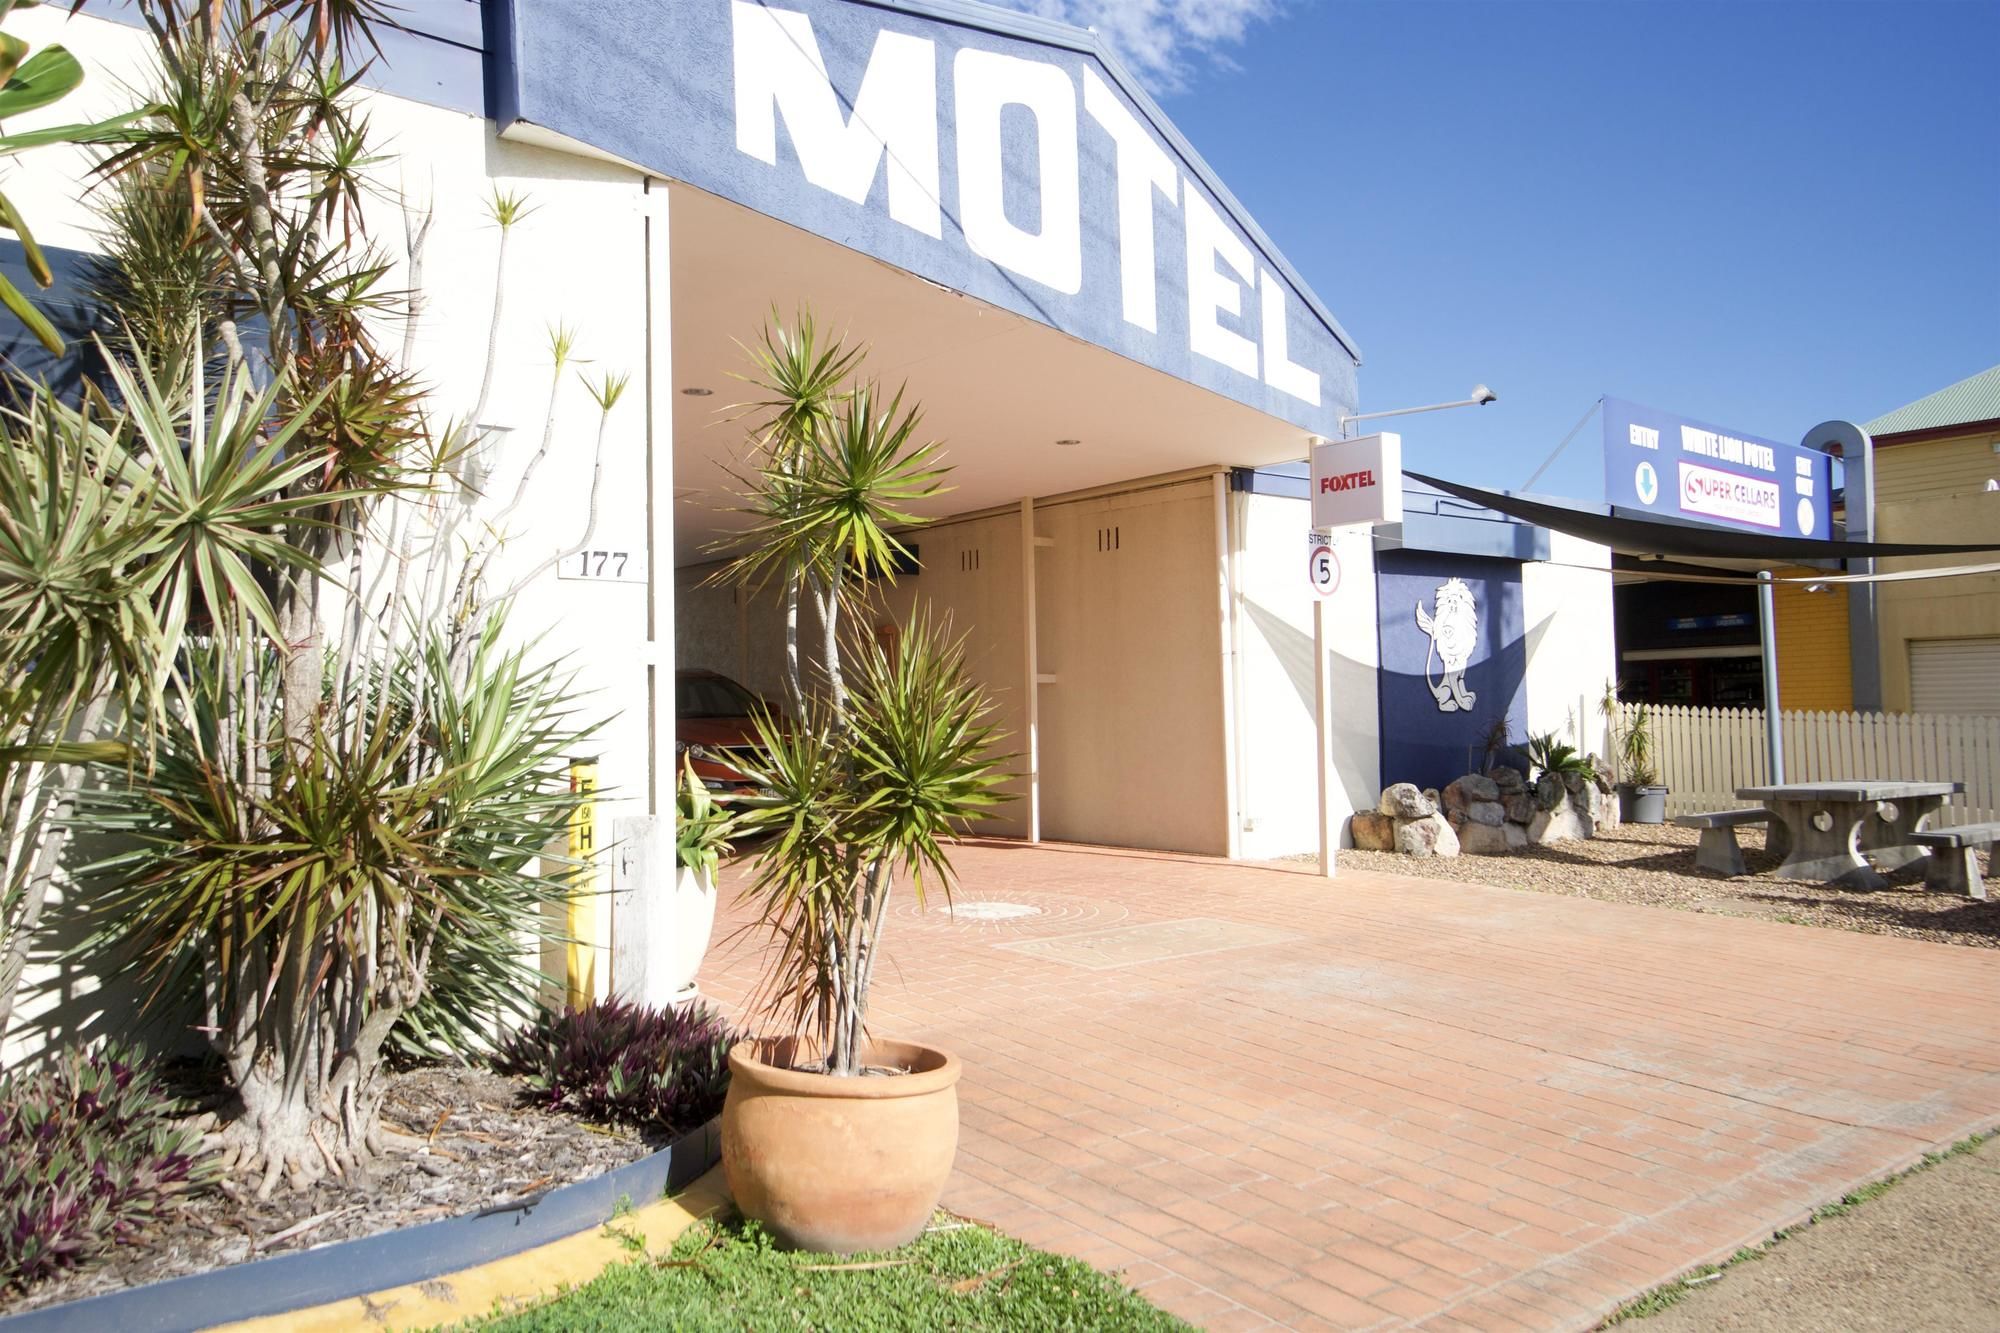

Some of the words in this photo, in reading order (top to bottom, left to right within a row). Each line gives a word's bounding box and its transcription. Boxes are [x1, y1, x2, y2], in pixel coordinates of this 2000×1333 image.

[732, 1, 1321, 407] MOTEL
[1321, 470, 1376, 494] FOXTEL
[1734, 484, 1776, 510] CELLARS
[581, 551, 628, 577] 177
[1320, 559, 1331, 584] 5
[580, 826, 592, 850] H
